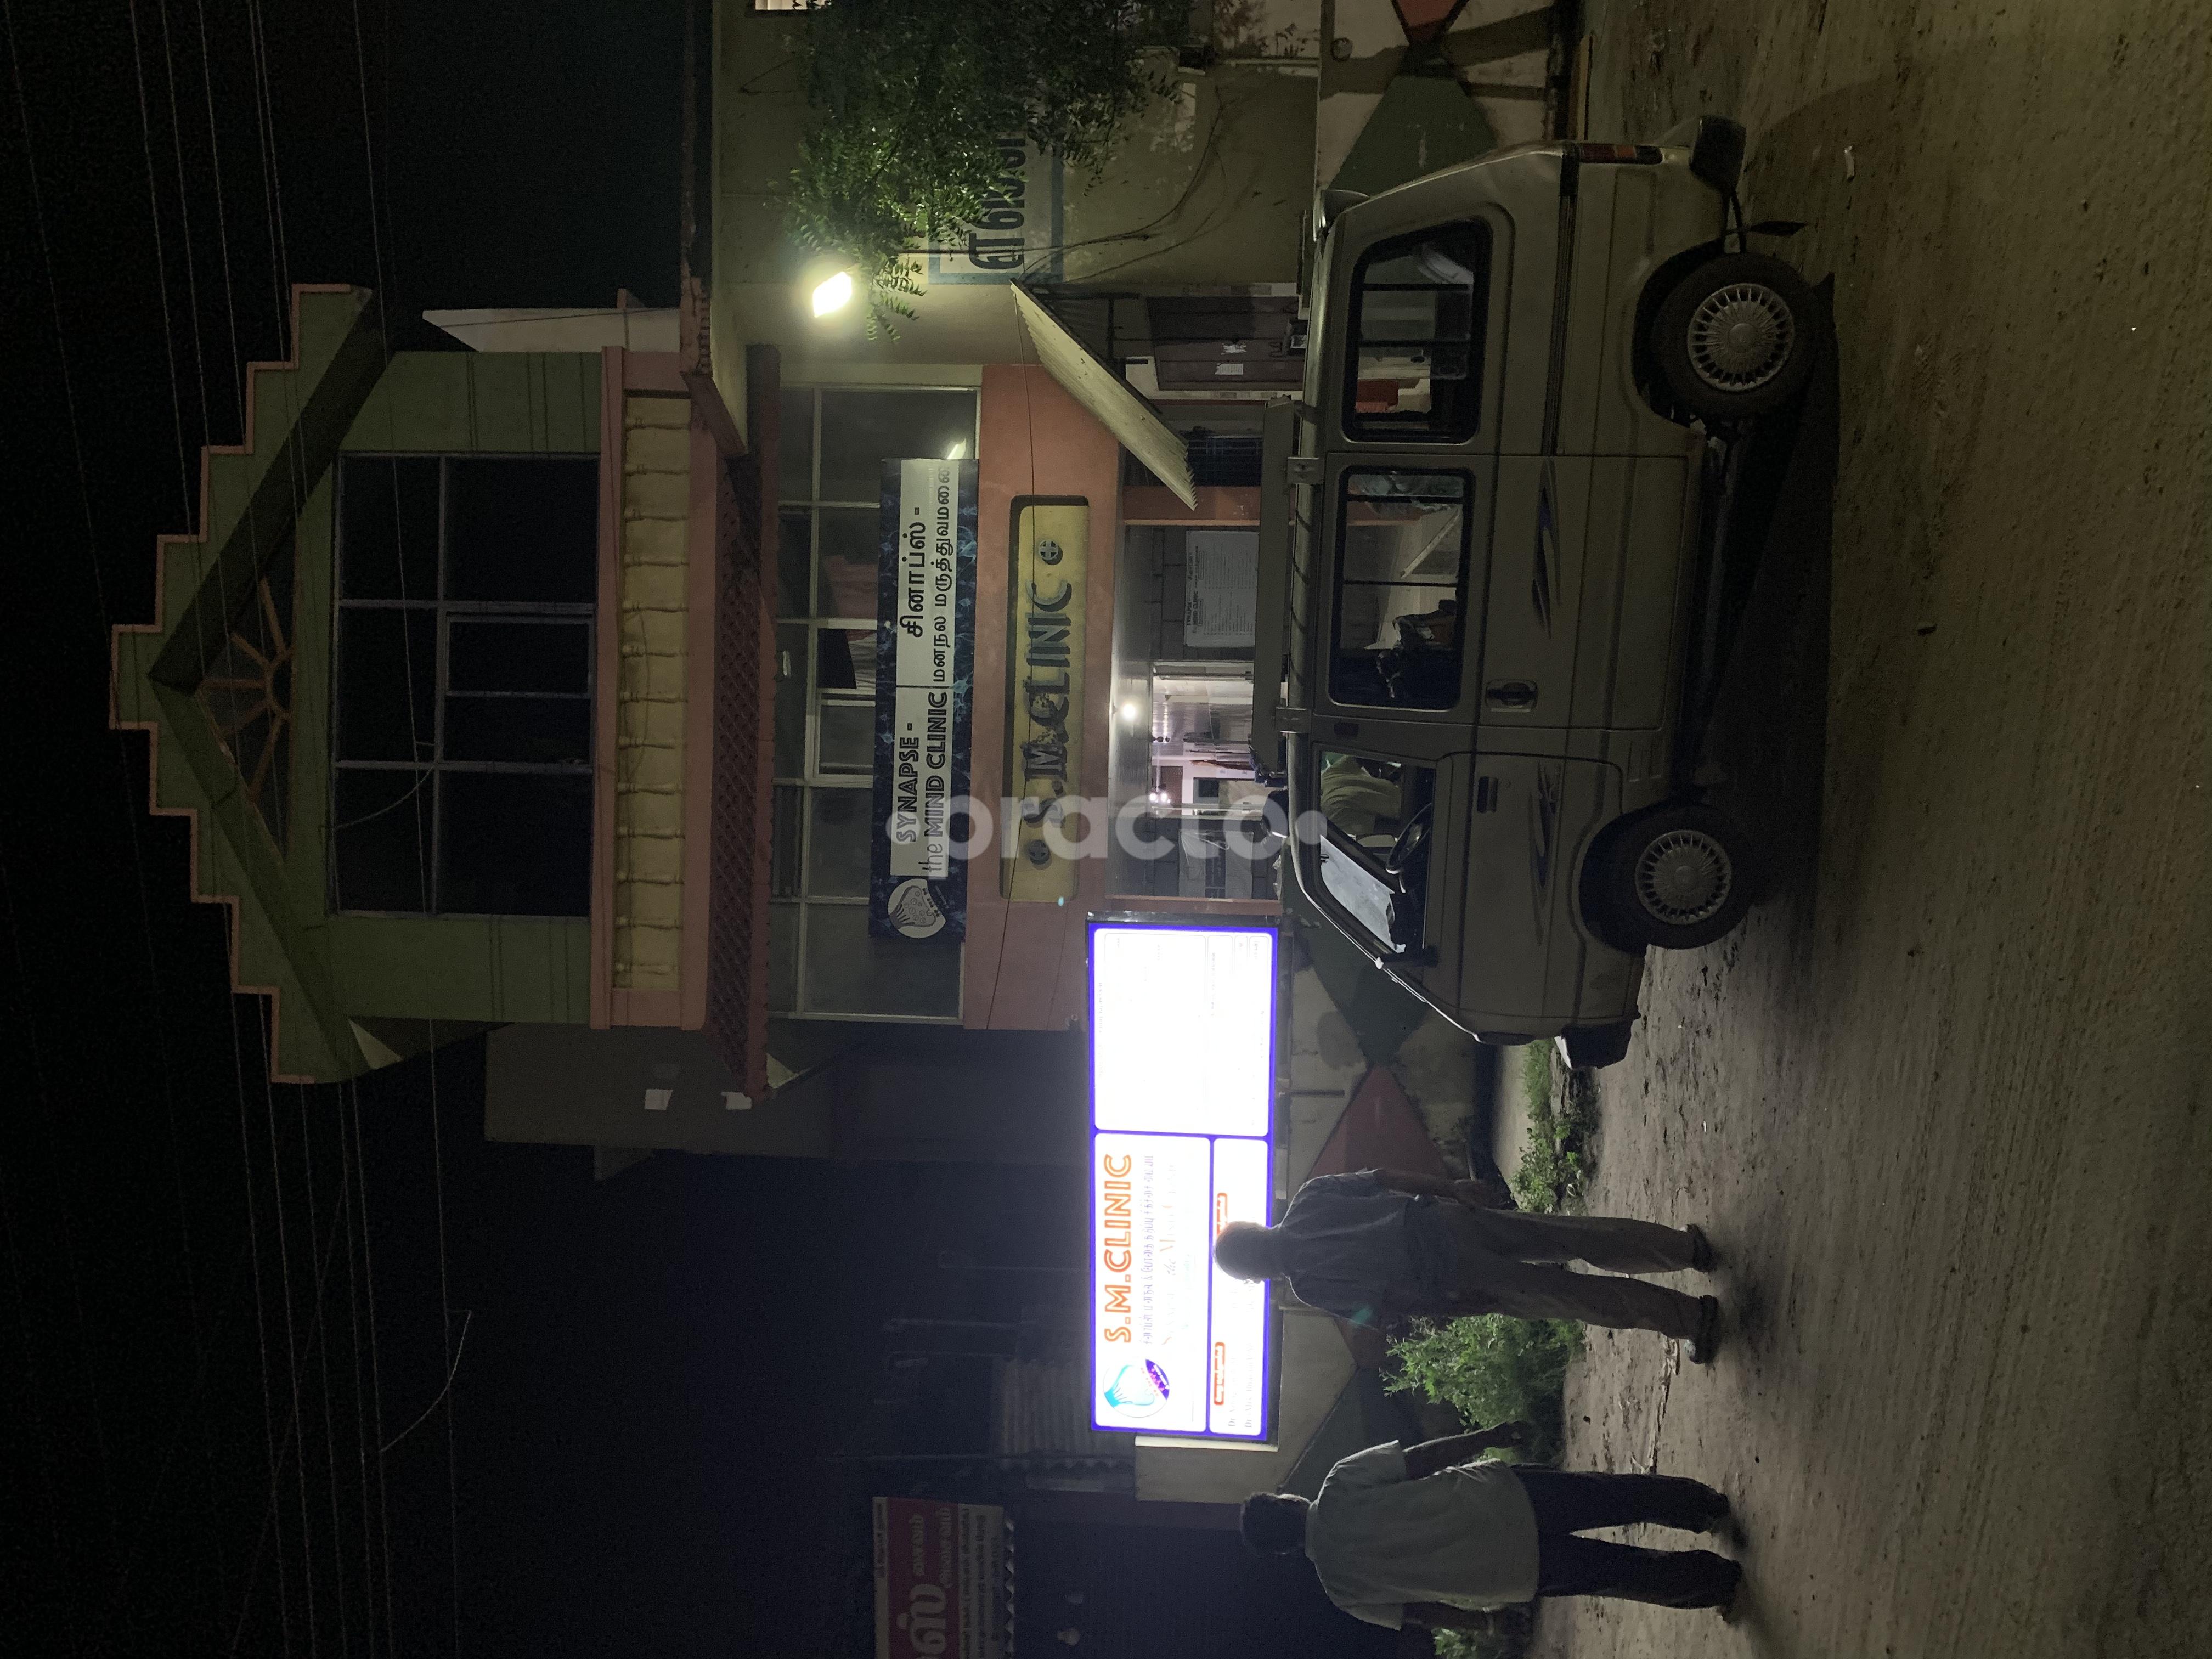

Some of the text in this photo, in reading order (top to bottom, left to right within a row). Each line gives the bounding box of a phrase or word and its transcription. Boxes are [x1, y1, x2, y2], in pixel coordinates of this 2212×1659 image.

[899, 522, 926, 637] சினாப்ஸ்
[933, 616, 951, 682] மனநல
[926, 692, 947, 769] CLINIC
[896, 737, 919, 842] SYNAPSE
[924, 775, 944, 837] MIND
[918, 844, 943, 873] the
[1104, 1154, 1131, 1343] S.M.CLINIC
